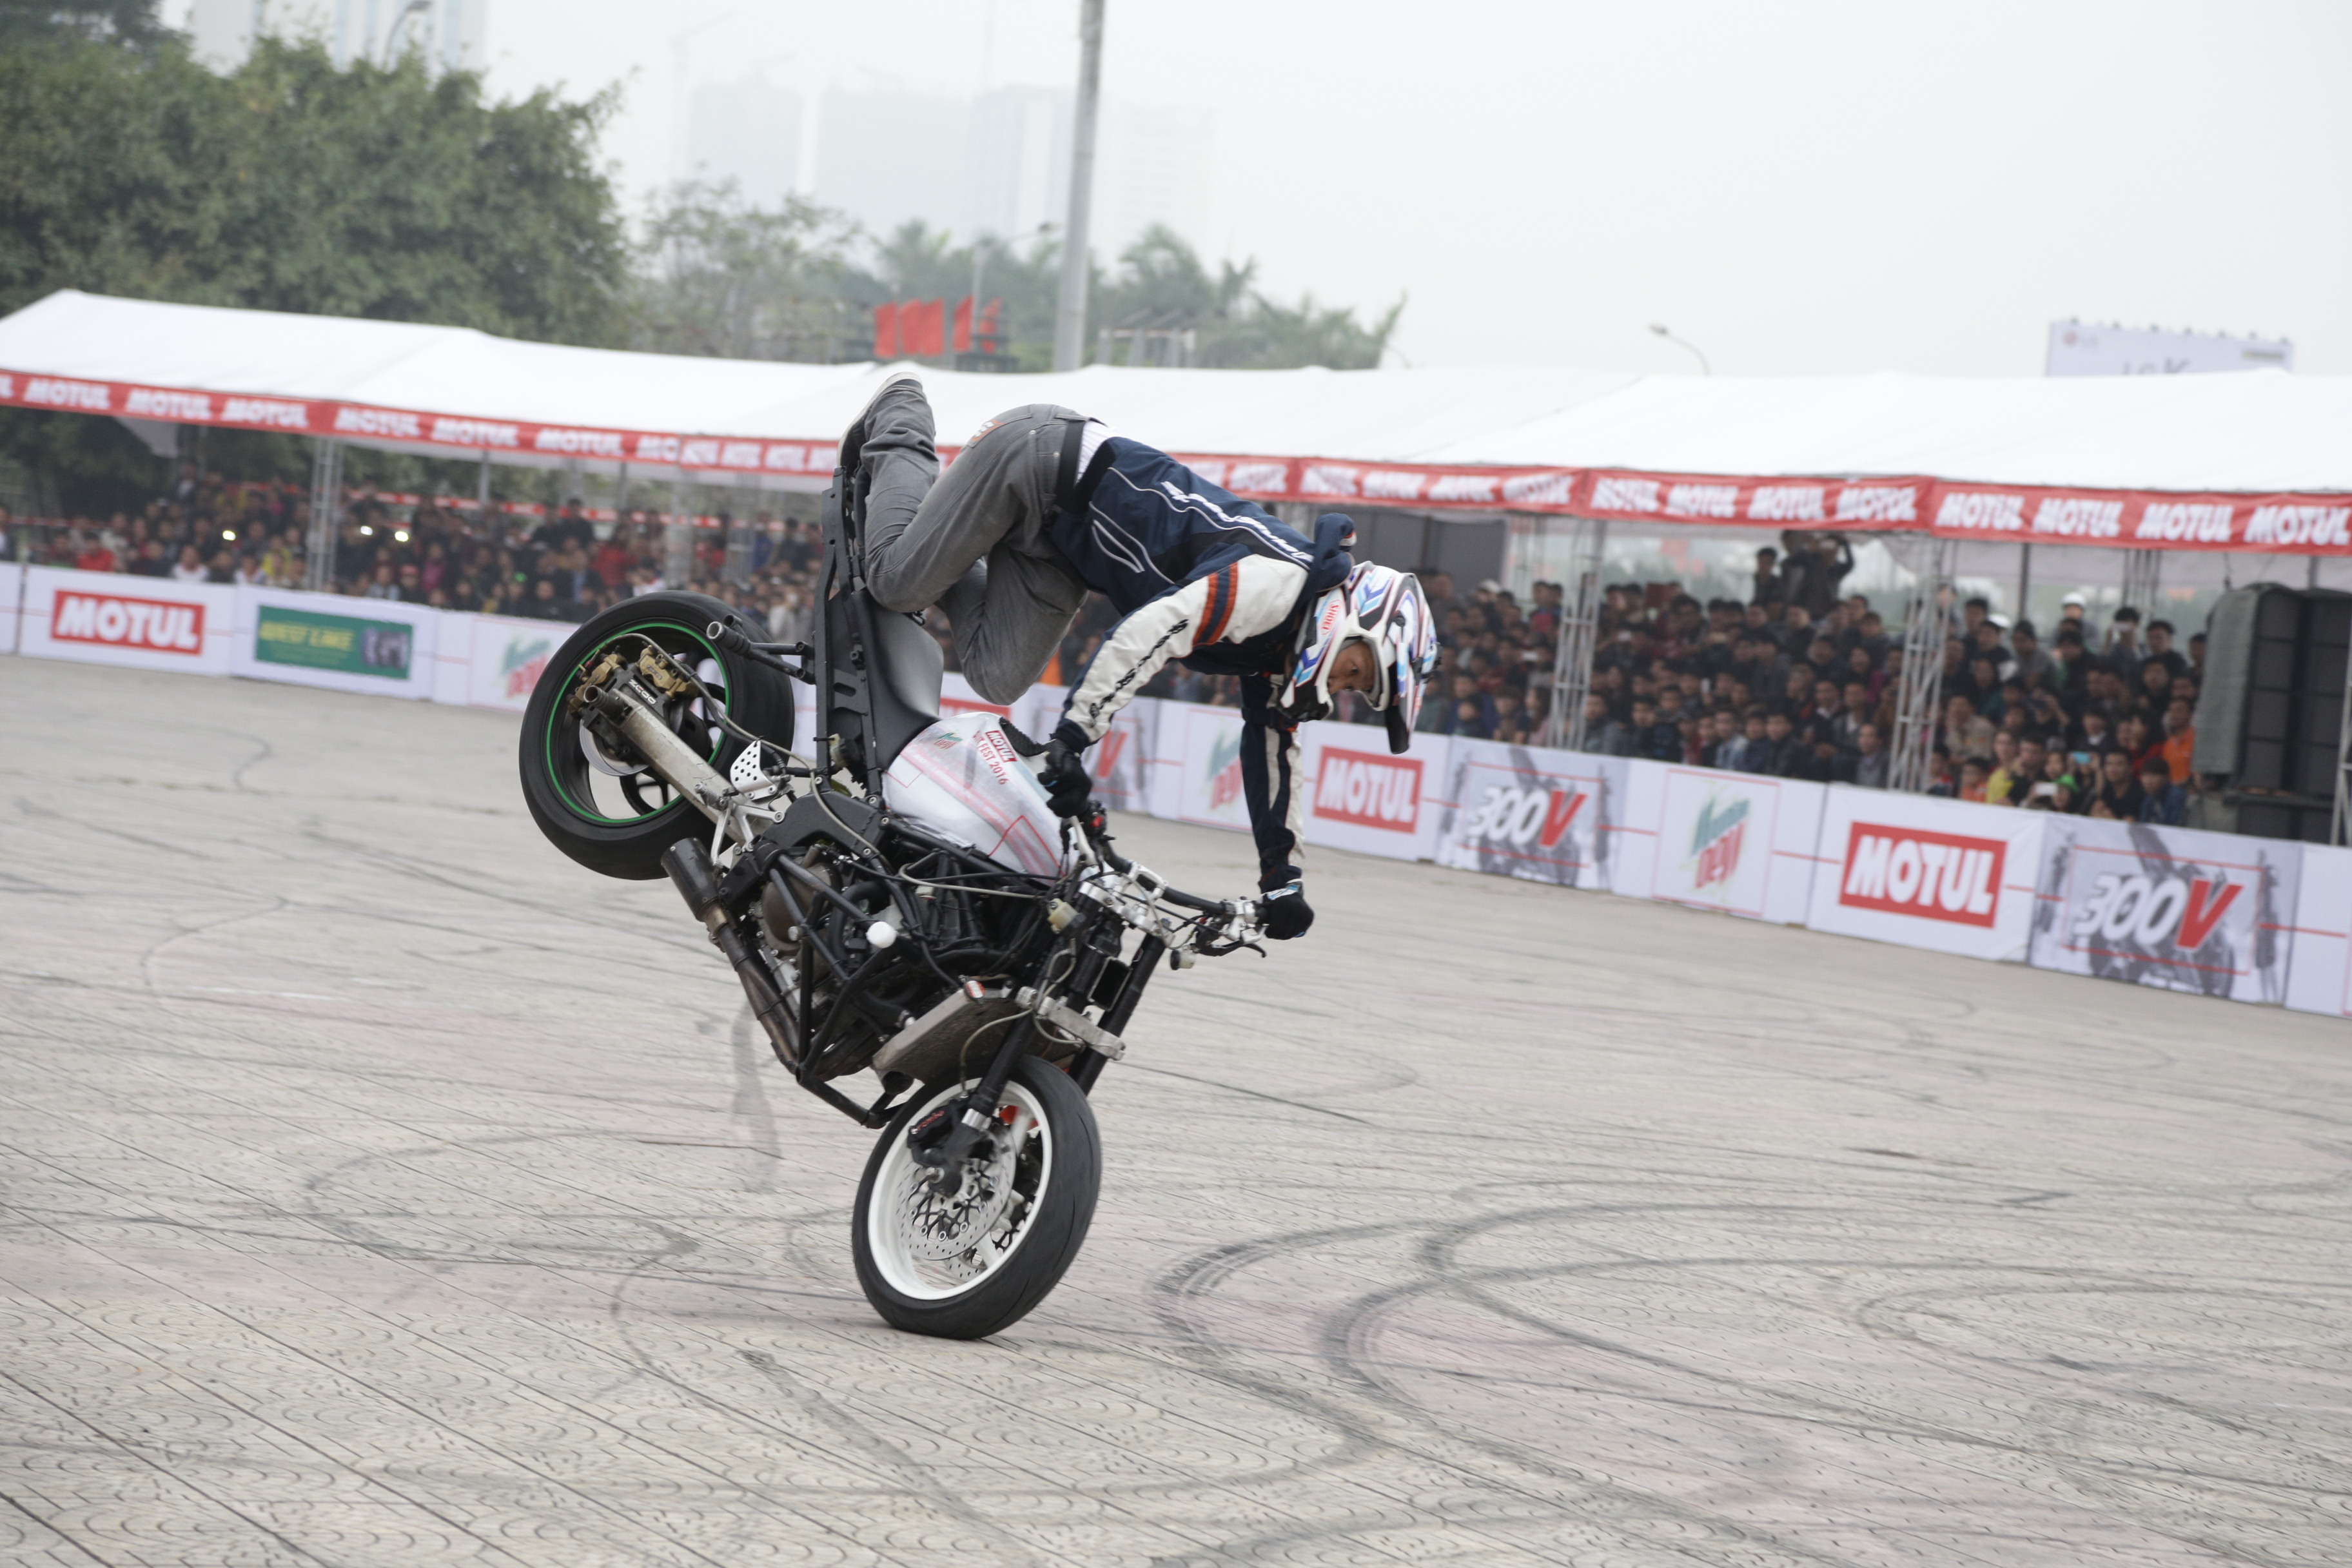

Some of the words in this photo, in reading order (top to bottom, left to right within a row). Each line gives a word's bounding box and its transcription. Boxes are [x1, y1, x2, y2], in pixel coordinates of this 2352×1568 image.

[23, 377, 112, 410] MOTUL
[124, 388, 213, 421] MOTUL
[221, 398, 309, 427] MOTUL
[430, 418, 519, 447] MOTUL
[534, 427, 624, 456] MOTUL
[1747, 487, 1826, 520] MOTUL
[1936, 493, 2026, 531] MOTUL
[2032, 498, 2124, 537] MOTUL
[2135, 504, 2235, 542] MOTUL
[2244, 506, 2351, 545] MOTUL
[56, 596, 198, 646] MOTUL
[628, 678, 657, 705] ZCOO
[977, 742, 997, 761] FEST
[989, 761, 1010, 785] 2016
[986, 730, 1015, 761] MOTUL
[1318, 757, 1416, 823] MOTUL
[1467, 784, 1589, 847] 300V
[1845, 835, 1995, 915] MOTUL
[2073, 873, 2245, 951] 300V
